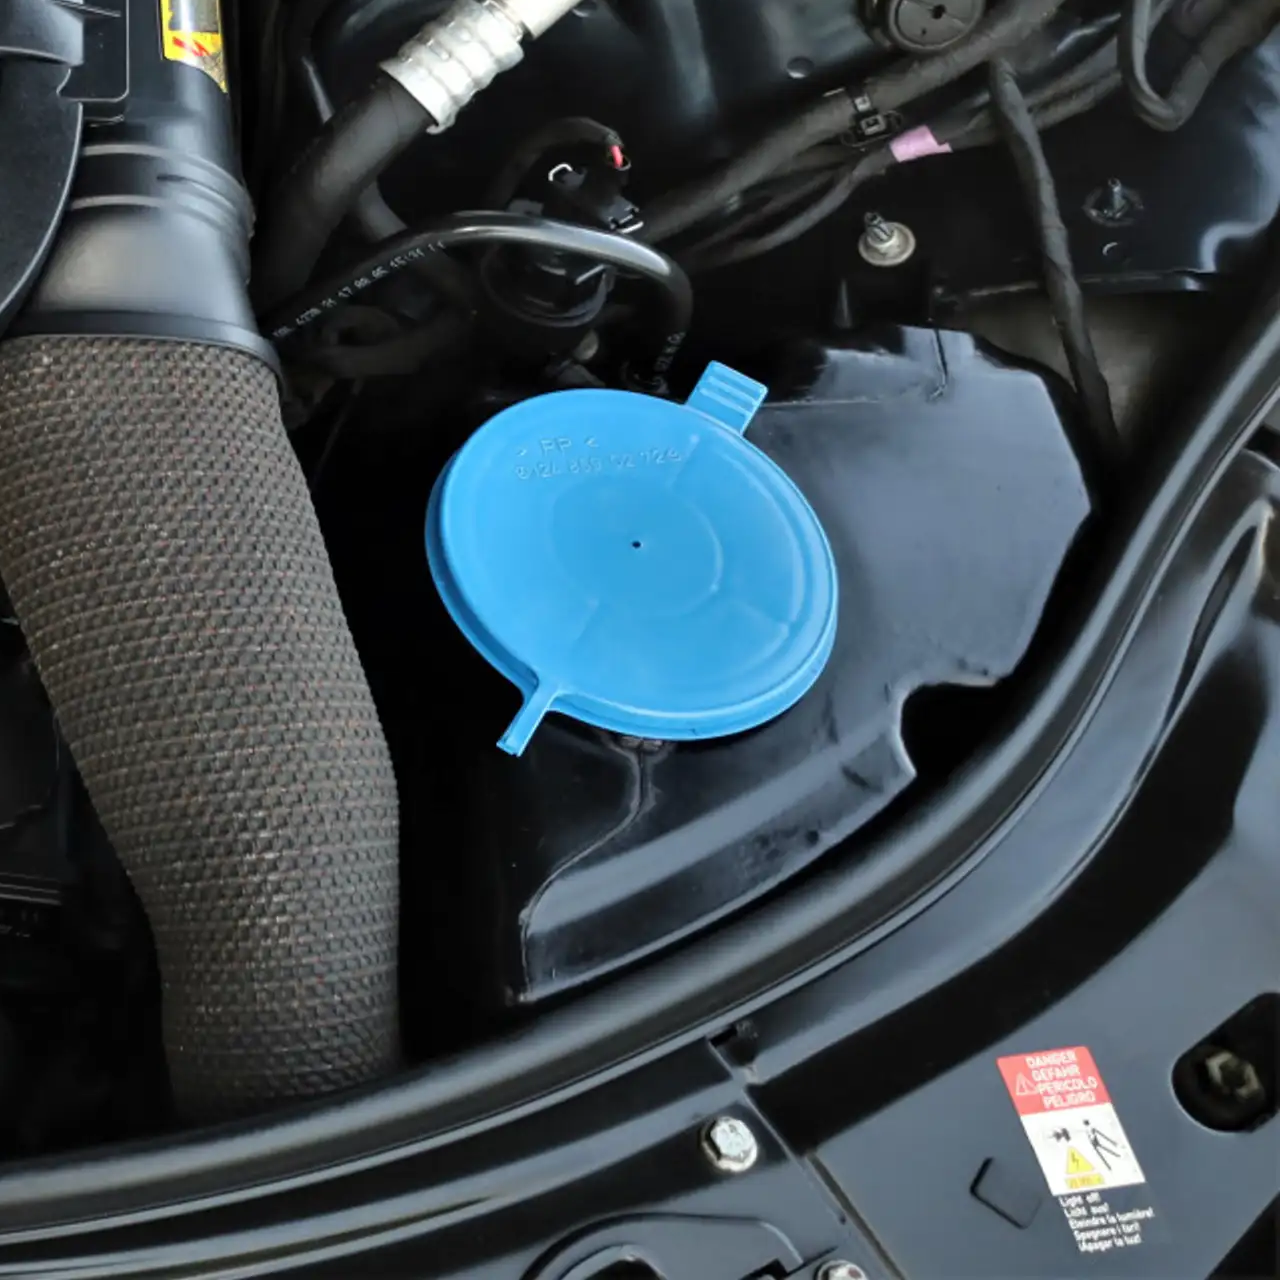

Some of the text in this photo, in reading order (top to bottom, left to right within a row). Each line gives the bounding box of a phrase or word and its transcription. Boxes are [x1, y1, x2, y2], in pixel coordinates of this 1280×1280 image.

[1025, 1050, 1077, 1069] DANGER
[1031, 1064, 1081, 1082] GEFAHR
[1037, 1076, 1098, 1094] PERICOLO
[1043, 1090, 1096, 1109] PELIGRO
